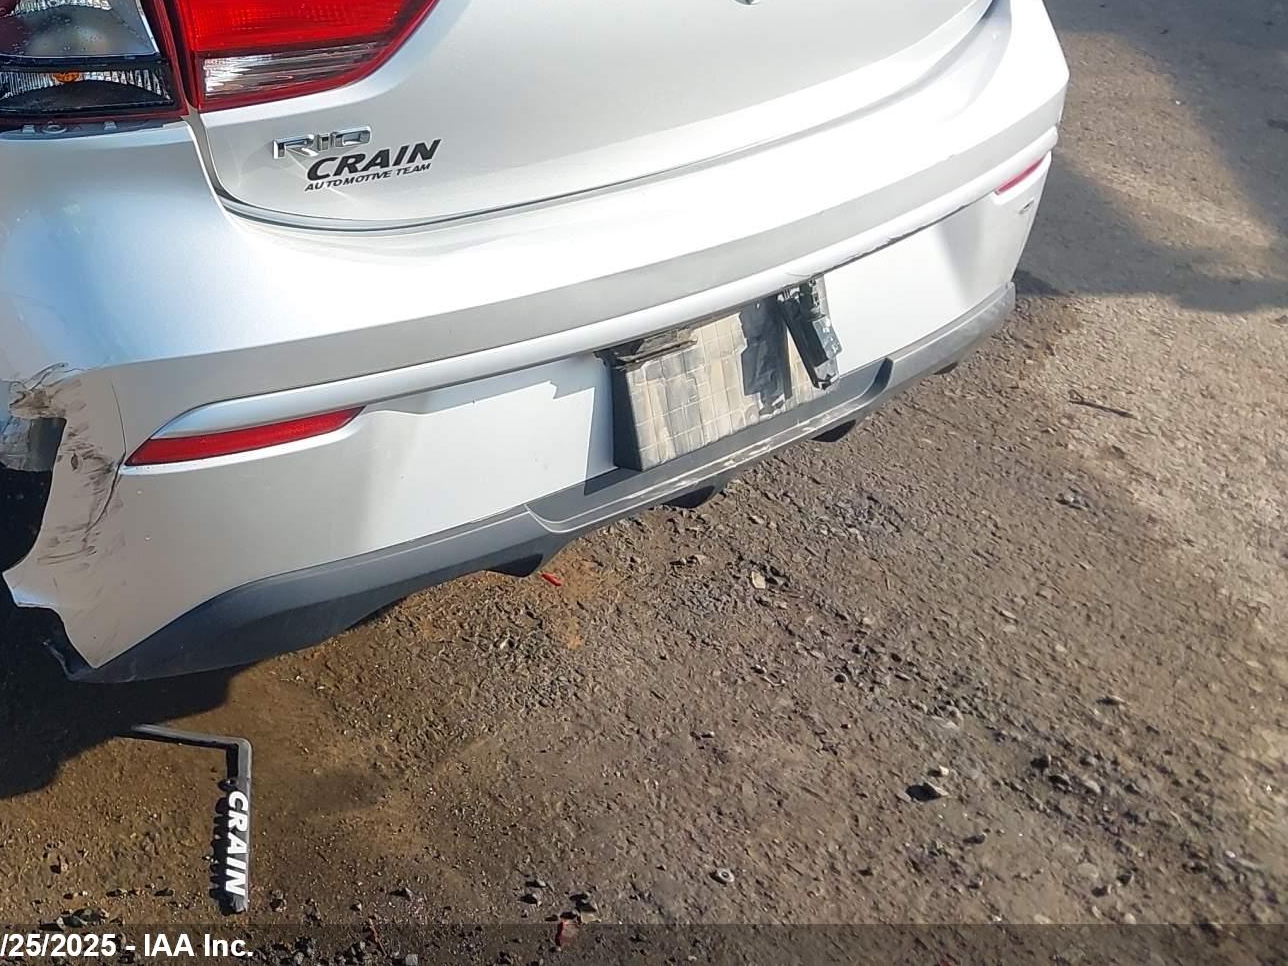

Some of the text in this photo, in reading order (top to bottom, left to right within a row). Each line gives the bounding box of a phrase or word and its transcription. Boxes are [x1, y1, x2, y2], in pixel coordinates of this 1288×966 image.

[304, 162, 432, 192] AUTOMOTIVE TEAM
[306, 139, 442, 181] CRAIN
[225, 790, 249, 896] CRAIN
